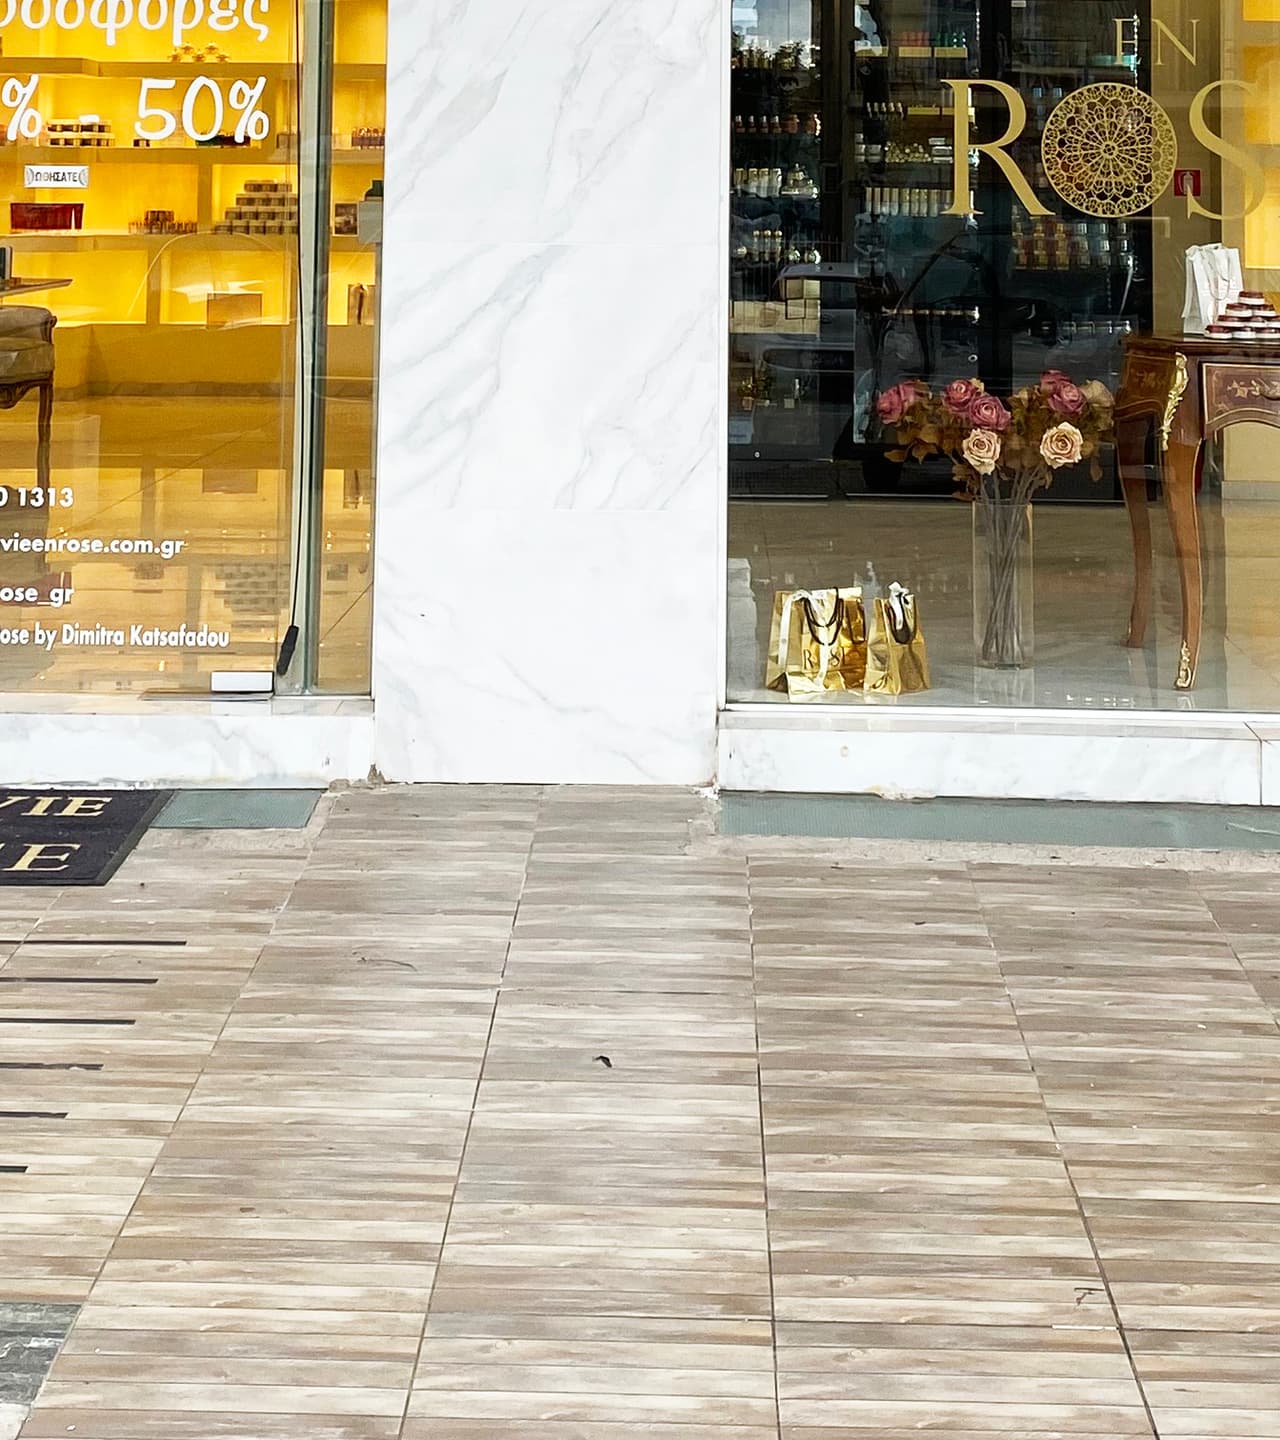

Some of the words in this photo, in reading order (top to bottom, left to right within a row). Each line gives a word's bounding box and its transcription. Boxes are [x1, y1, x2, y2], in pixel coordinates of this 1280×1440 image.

[1111, 17, 1201, 67] EN
[133, 75, 271, 144] 50%
[18, 486, 75, 508] 1313
[34, 621, 56, 651] by
[61, 622, 126, 647] Dimitra
[129, 623, 231, 648] Katsafadou
